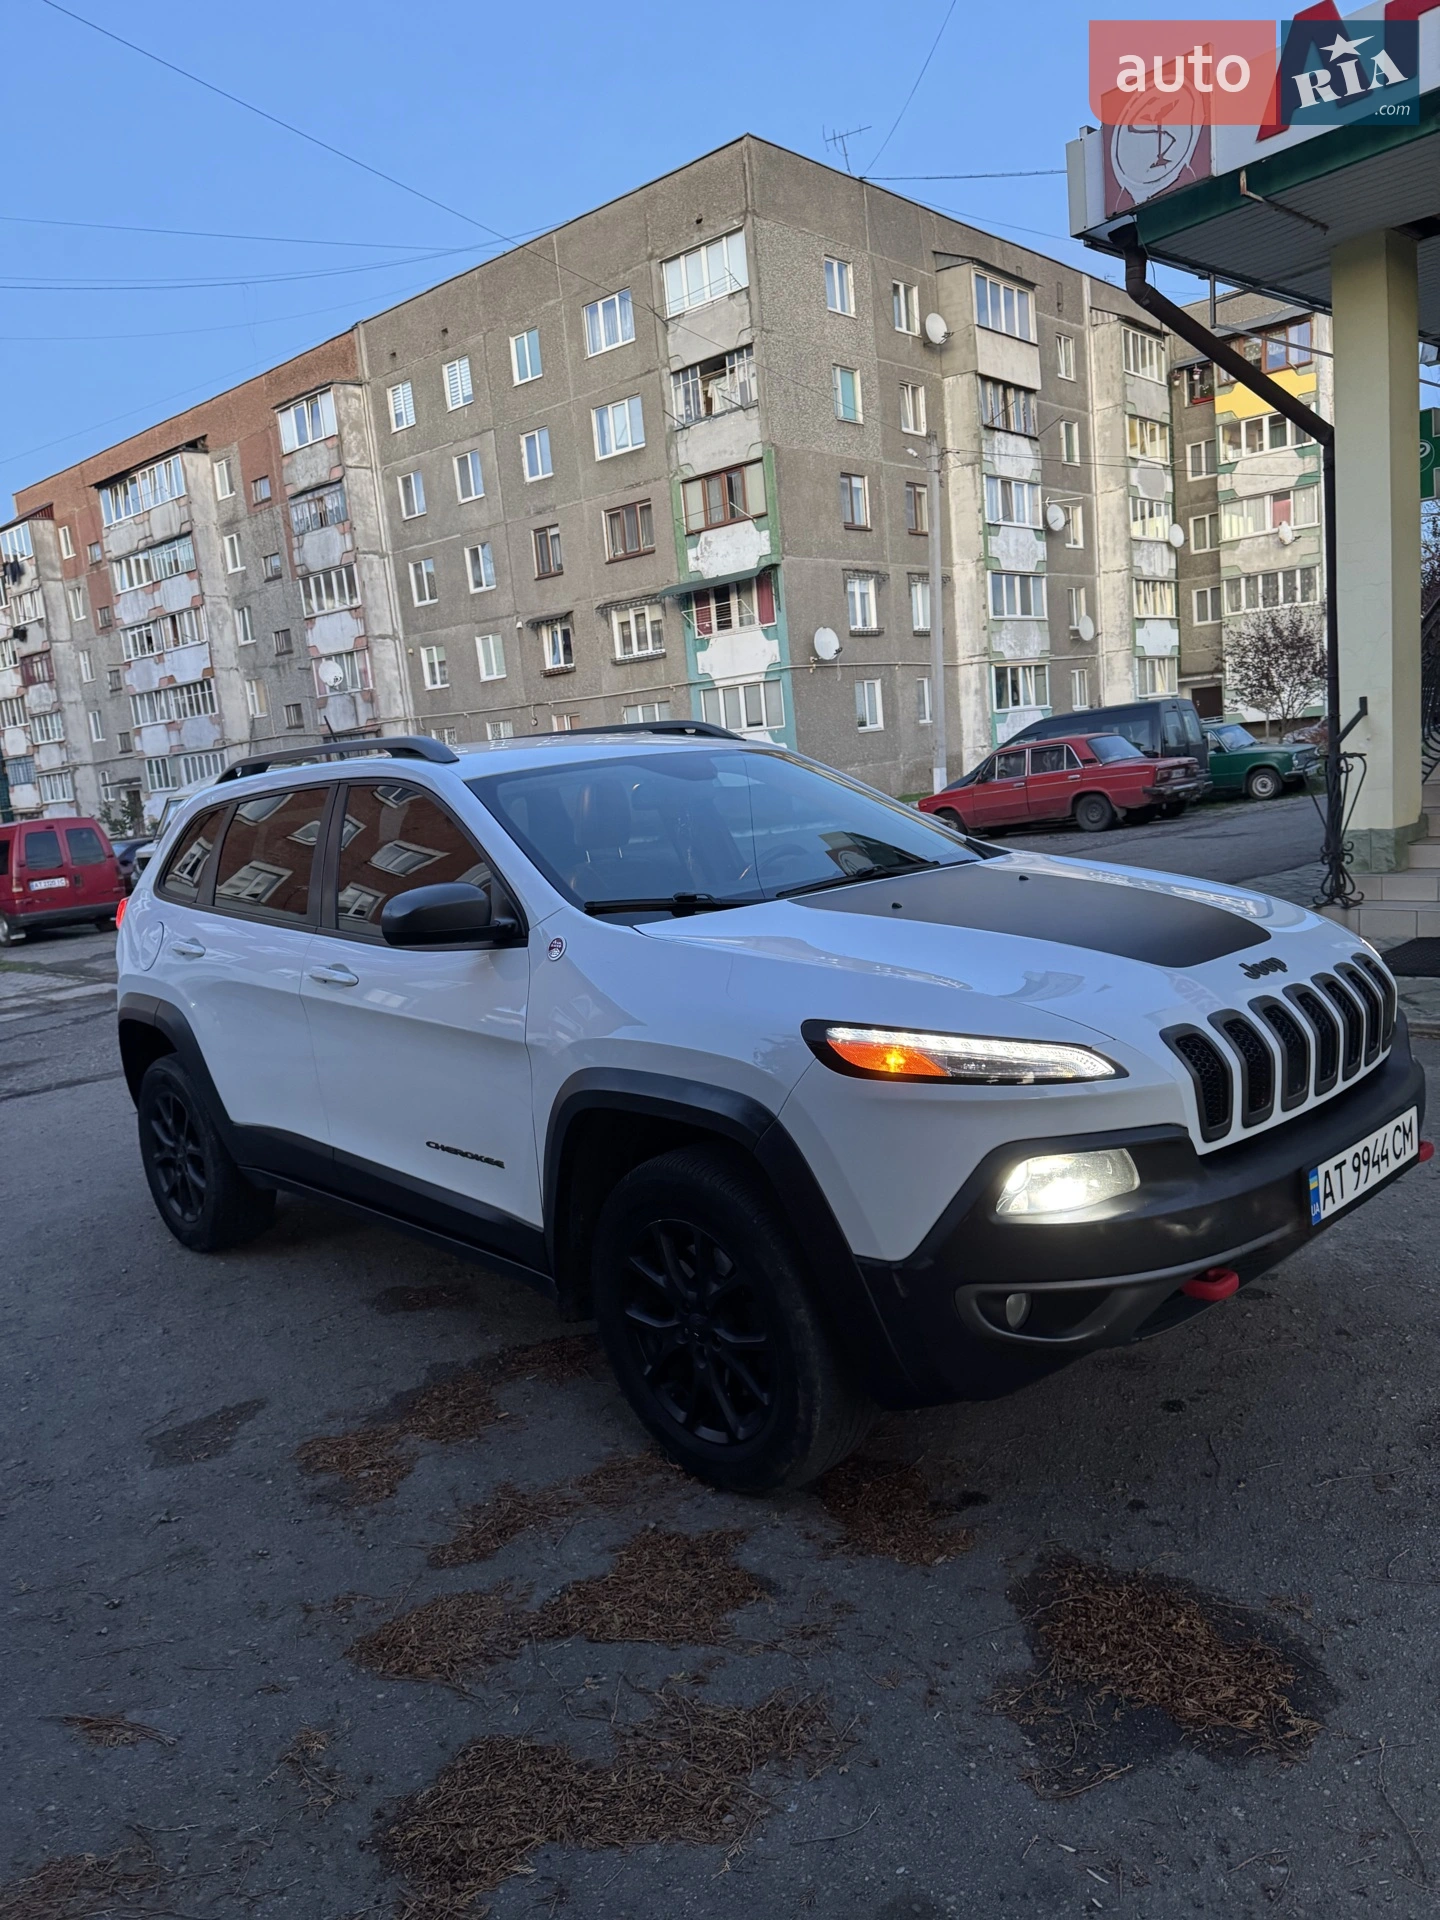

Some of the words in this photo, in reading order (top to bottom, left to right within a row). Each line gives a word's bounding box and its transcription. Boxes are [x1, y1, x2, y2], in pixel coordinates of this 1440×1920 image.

[1239, 957, 1288, 979] Jeep
[426, 1141, 505, 1169] CHEROKEE
[1323, 1159, 1346, 1211] AT
[1352, 1132, 1389, 1191] 9944
[1392, 1115, 1414, 1160] CM
[1311, 1202, 1321, 1217] UA
